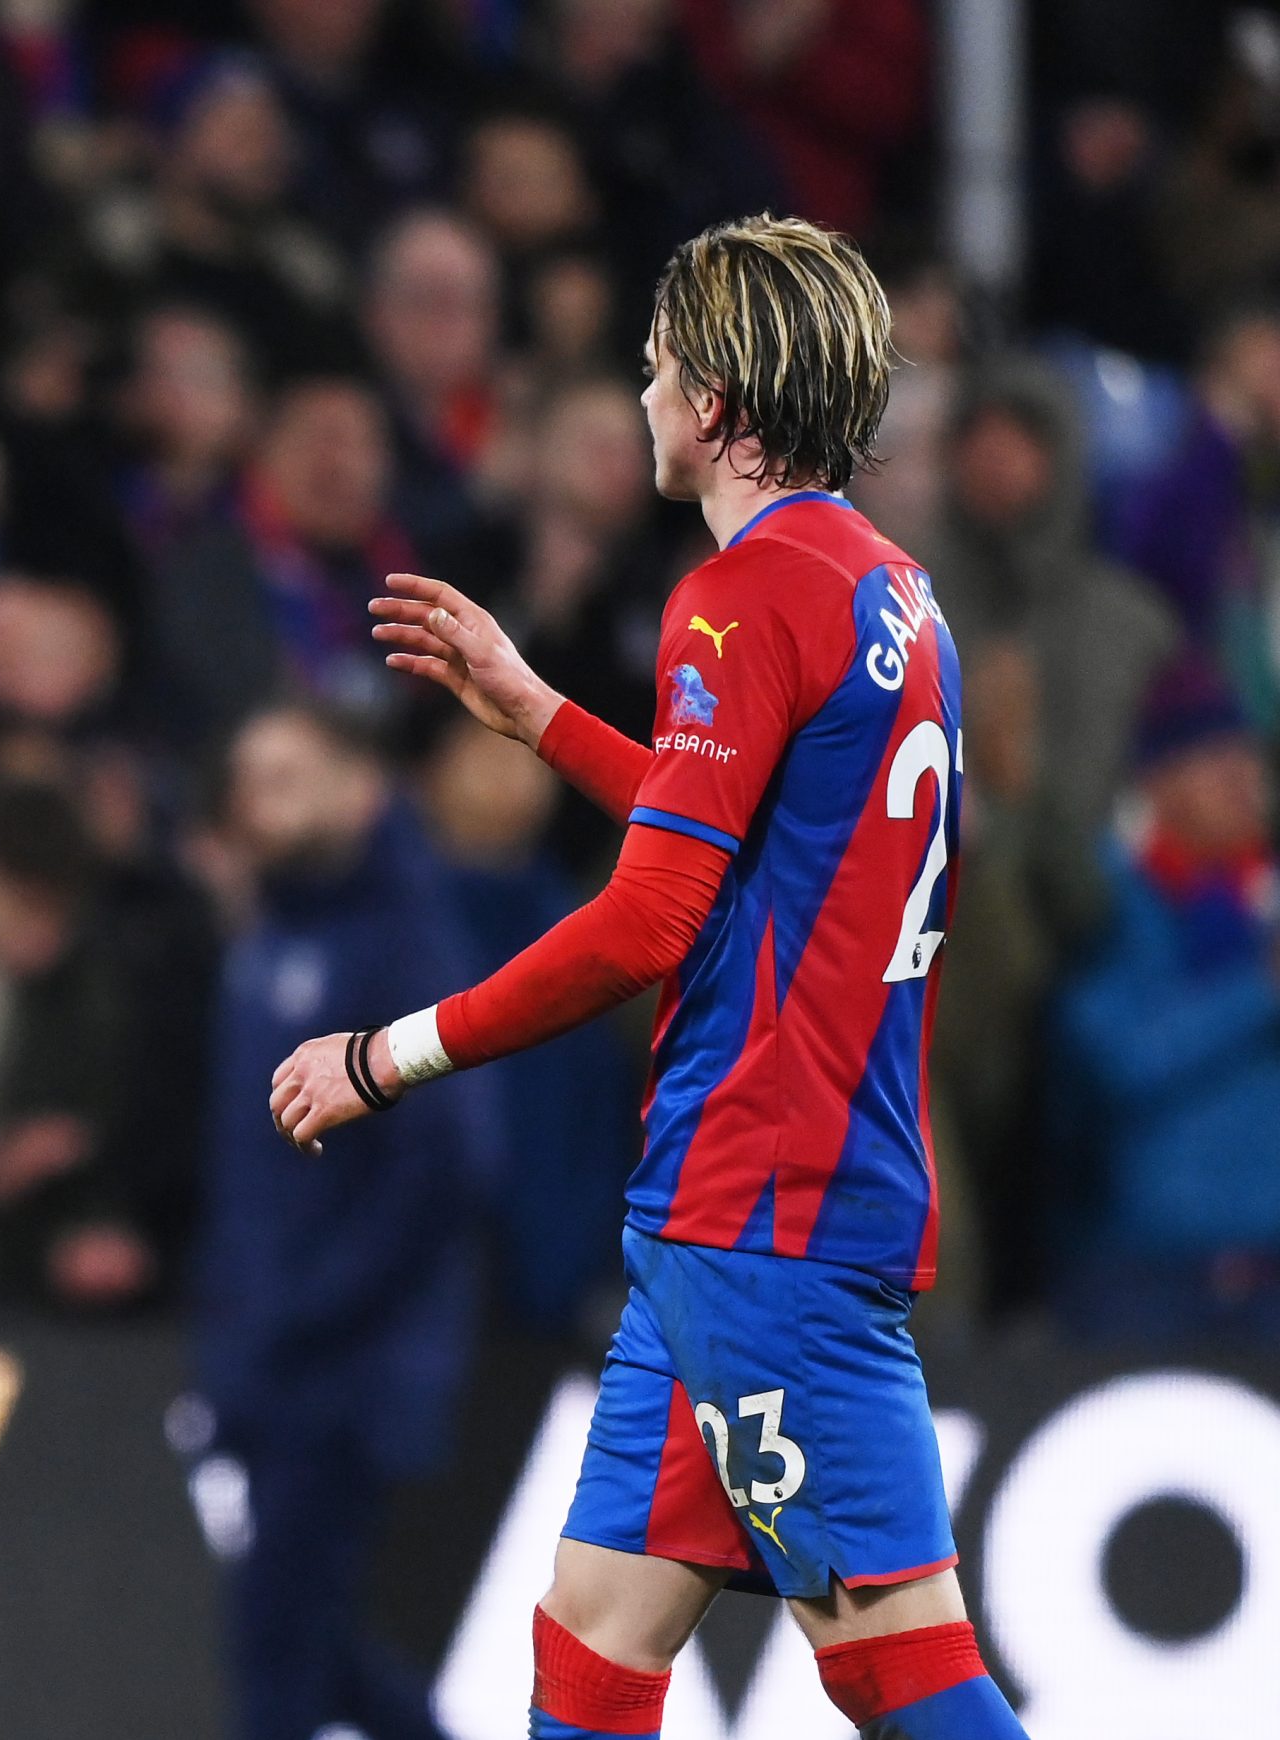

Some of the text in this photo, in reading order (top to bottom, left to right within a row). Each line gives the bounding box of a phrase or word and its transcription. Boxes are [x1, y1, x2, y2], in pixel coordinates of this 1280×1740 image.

[866, 568, 951, 691] GALLAG
[882, 720, 964, 983] 2
[694, 1388, 806, 1508] 23
